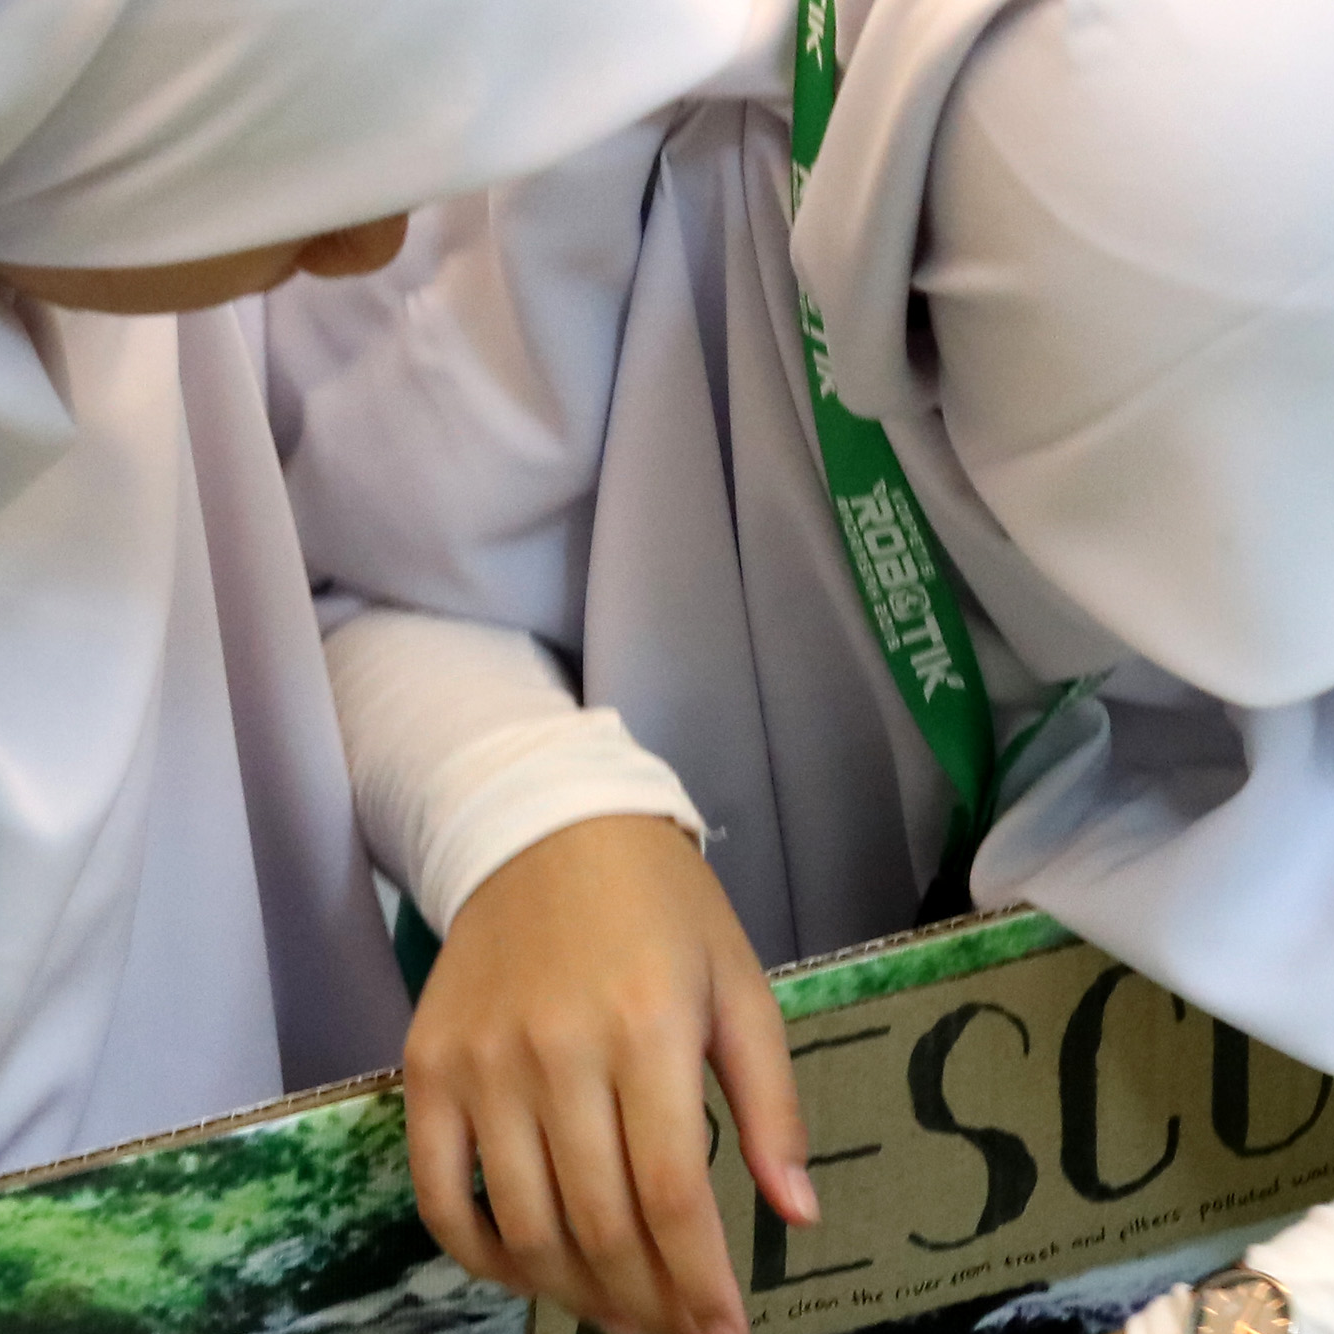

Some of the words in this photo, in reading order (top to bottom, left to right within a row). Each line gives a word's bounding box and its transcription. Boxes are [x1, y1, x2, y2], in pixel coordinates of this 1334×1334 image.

[849, 477, 965, 704] ROBOTIK
[787, 1293, 840, 1322] clean
[851, 1284, 885, 1307] the
[895, 1276, 943, 1303] river
[1070, 1226, 1108, 1251] and
[1199, 1178, 1282, 1223] polluted
